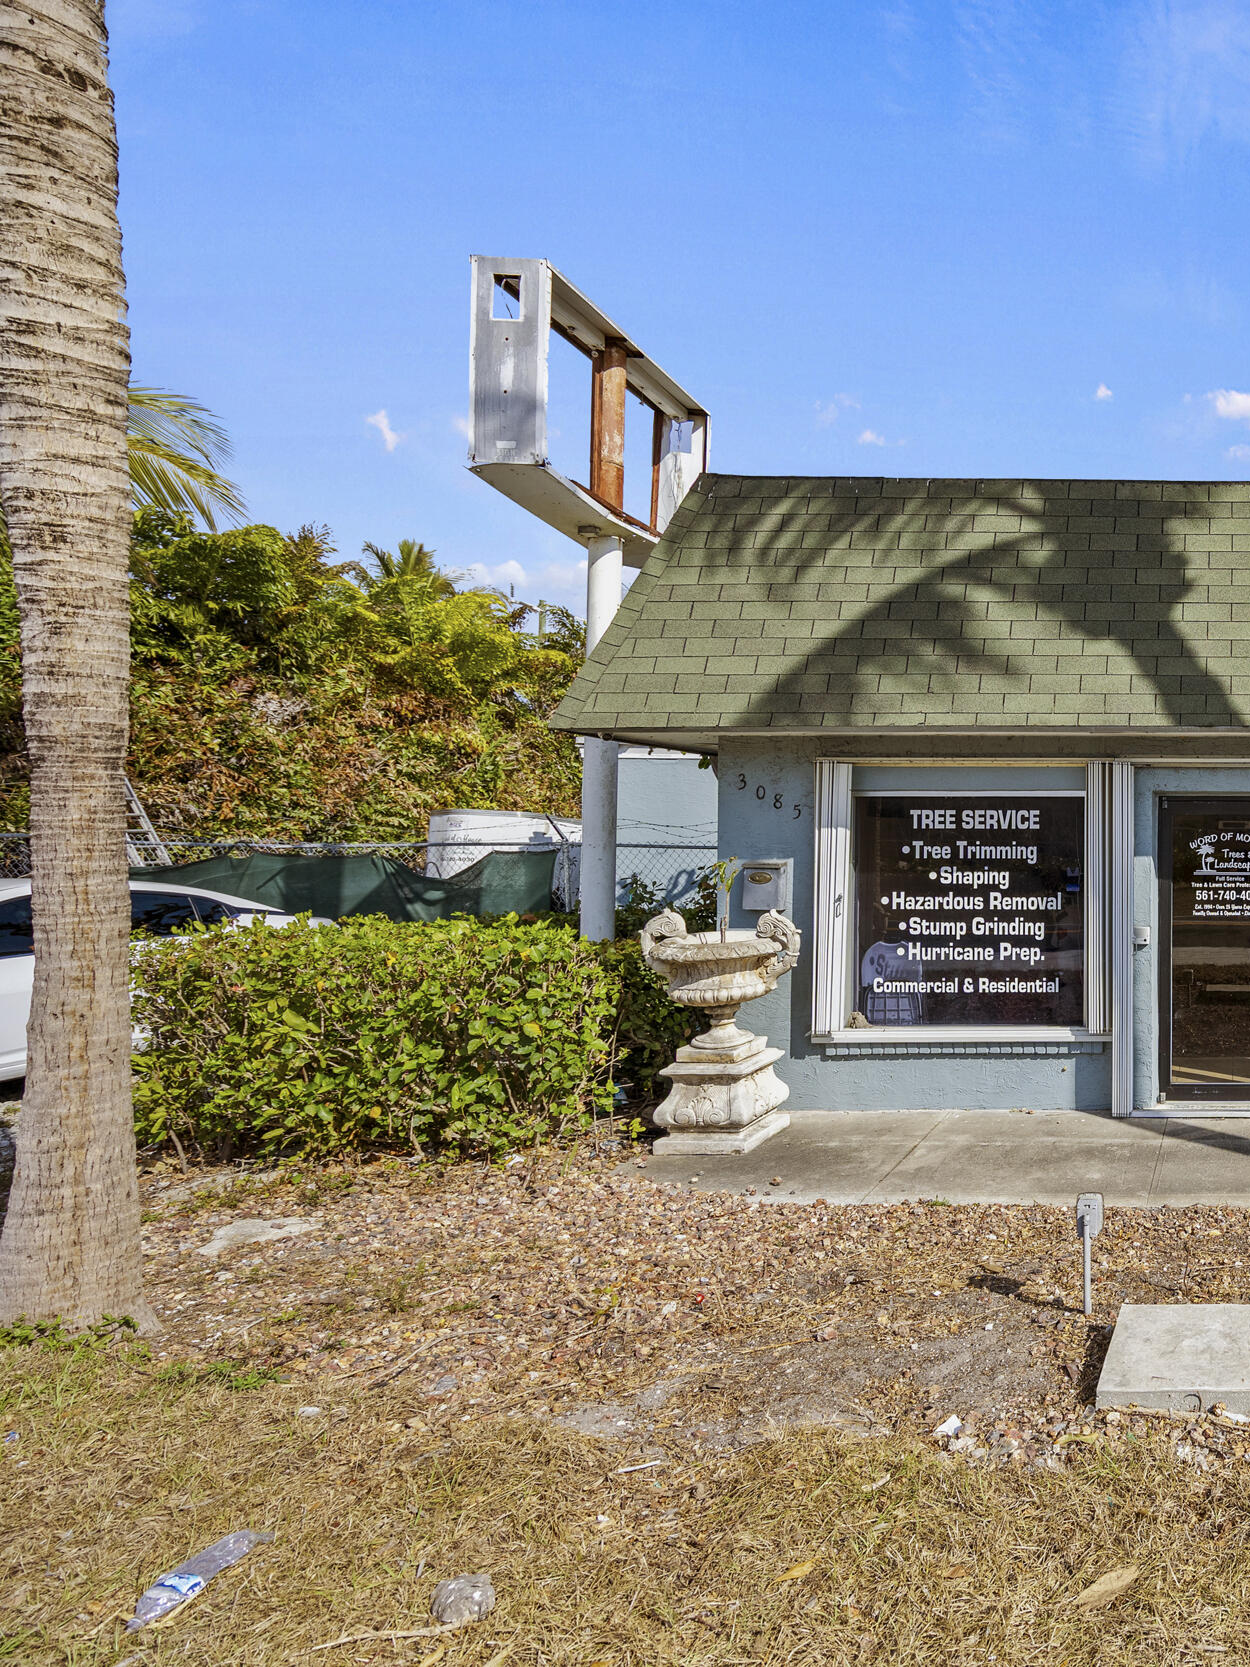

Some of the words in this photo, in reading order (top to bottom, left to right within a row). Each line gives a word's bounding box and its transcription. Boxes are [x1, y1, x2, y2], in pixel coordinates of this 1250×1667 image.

[737, 773, 801, 820] 3085
[909, 809, 956, 829] TREE
[961, 809, 1040, 830] SERVICE
[1189, 834, 1218, 849] WORD
[1220, 832, 1234, 841] OF
[912, 840, 951, 859] Tree
[956, 840, 1037, 864] Trimming
[1221, 848, 1245, 859] Trees
[939, 866, 1010, 890] Shaping
[891, 891, 984, 910] Hazardous
[989, 891, 1062, 911] Removal
[908, 916, 967, 940] Stump
[971, 916, 1045, 940] Grinding
[907, 941, 994, 961] Hurricane
[999, 941, 1046, 965] Prep.
[872, 976, 959, 993] Commercial
[962, 976, 975, 993] &
[978, 977, 1060, 993] Residential
